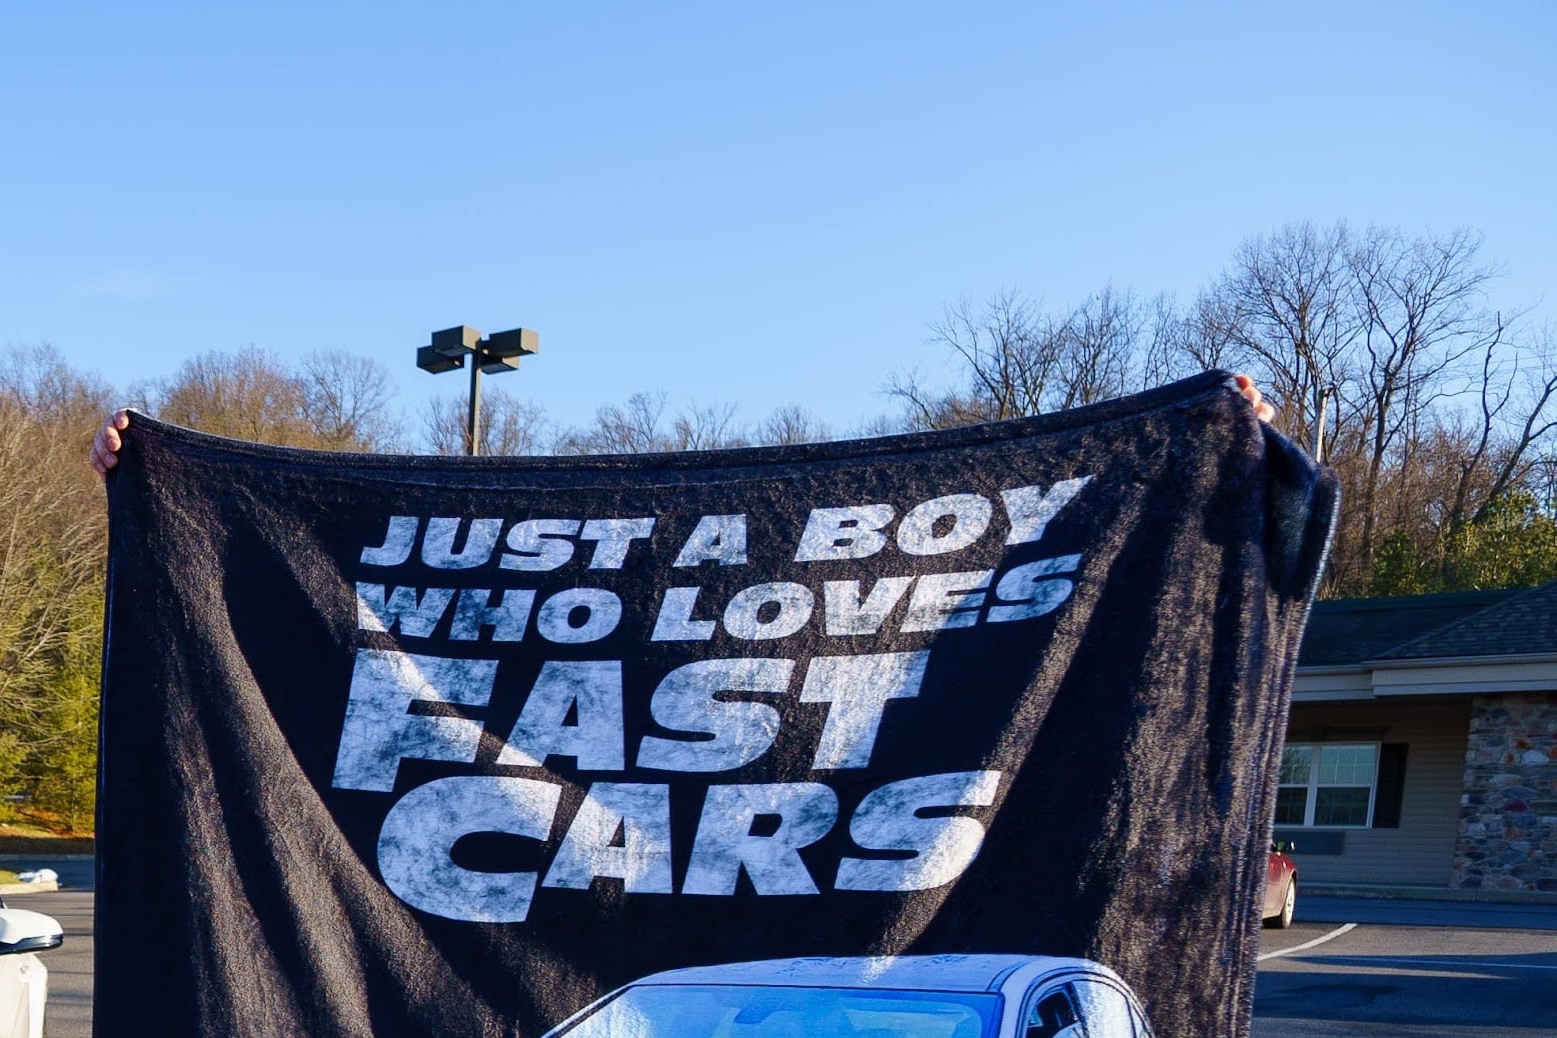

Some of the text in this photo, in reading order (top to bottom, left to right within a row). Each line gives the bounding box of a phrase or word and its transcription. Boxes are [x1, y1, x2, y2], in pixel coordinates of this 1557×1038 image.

[360, 474, 1096, 571] JUST A BOY
[356, 553, 1084, 643] WHO LOVES
[332, 647, 931, 793] FAST
[377, 769, 1003, 924] CARS
